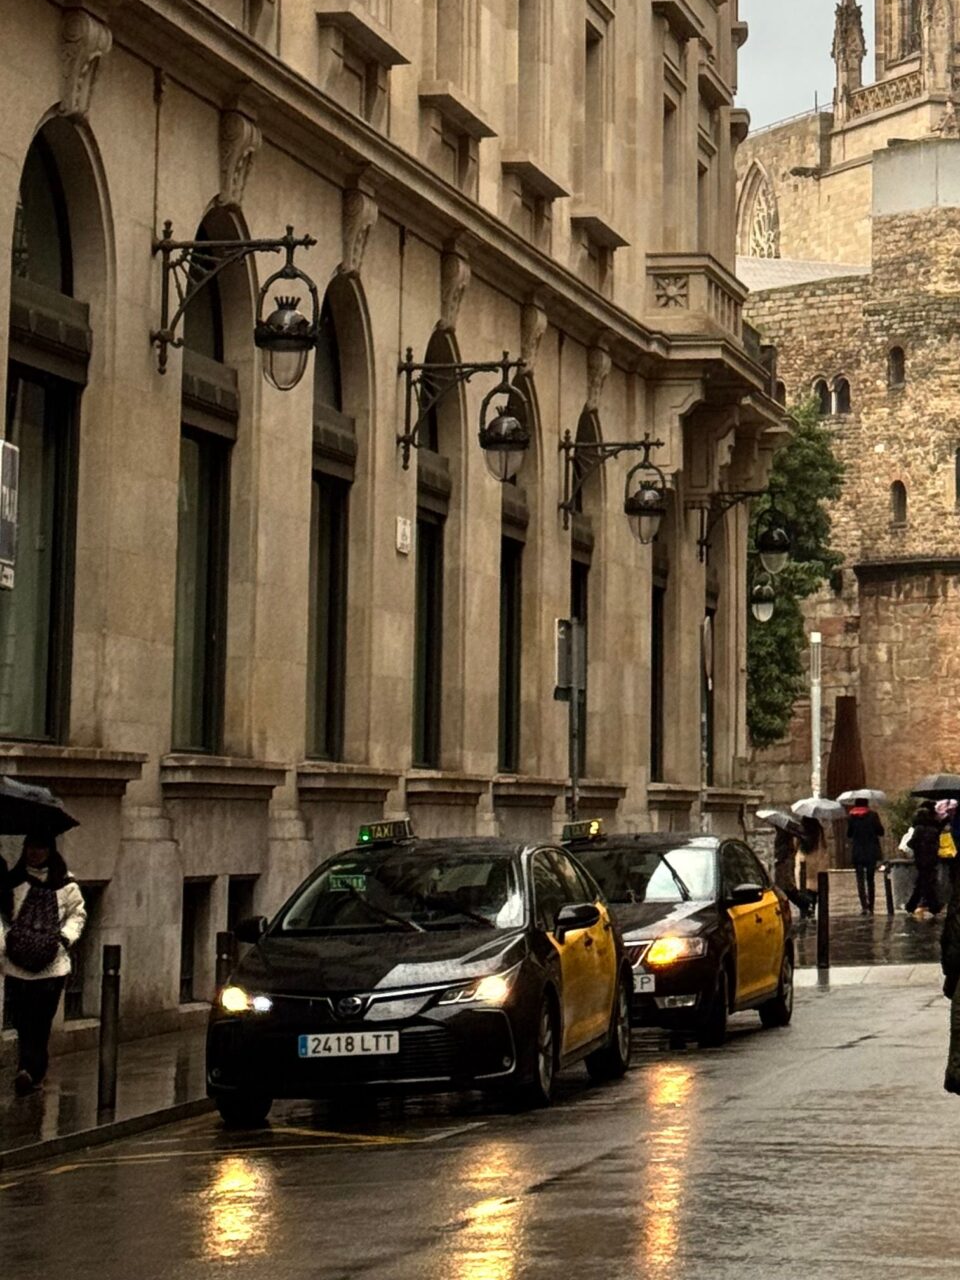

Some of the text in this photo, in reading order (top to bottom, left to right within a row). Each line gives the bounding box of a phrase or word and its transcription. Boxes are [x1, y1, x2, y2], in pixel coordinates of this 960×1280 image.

[371, 823, 394, 839] TAXI
[590, 821, 599, 835] 2
[311, 1033, 394, 1054] 2418 LTT
